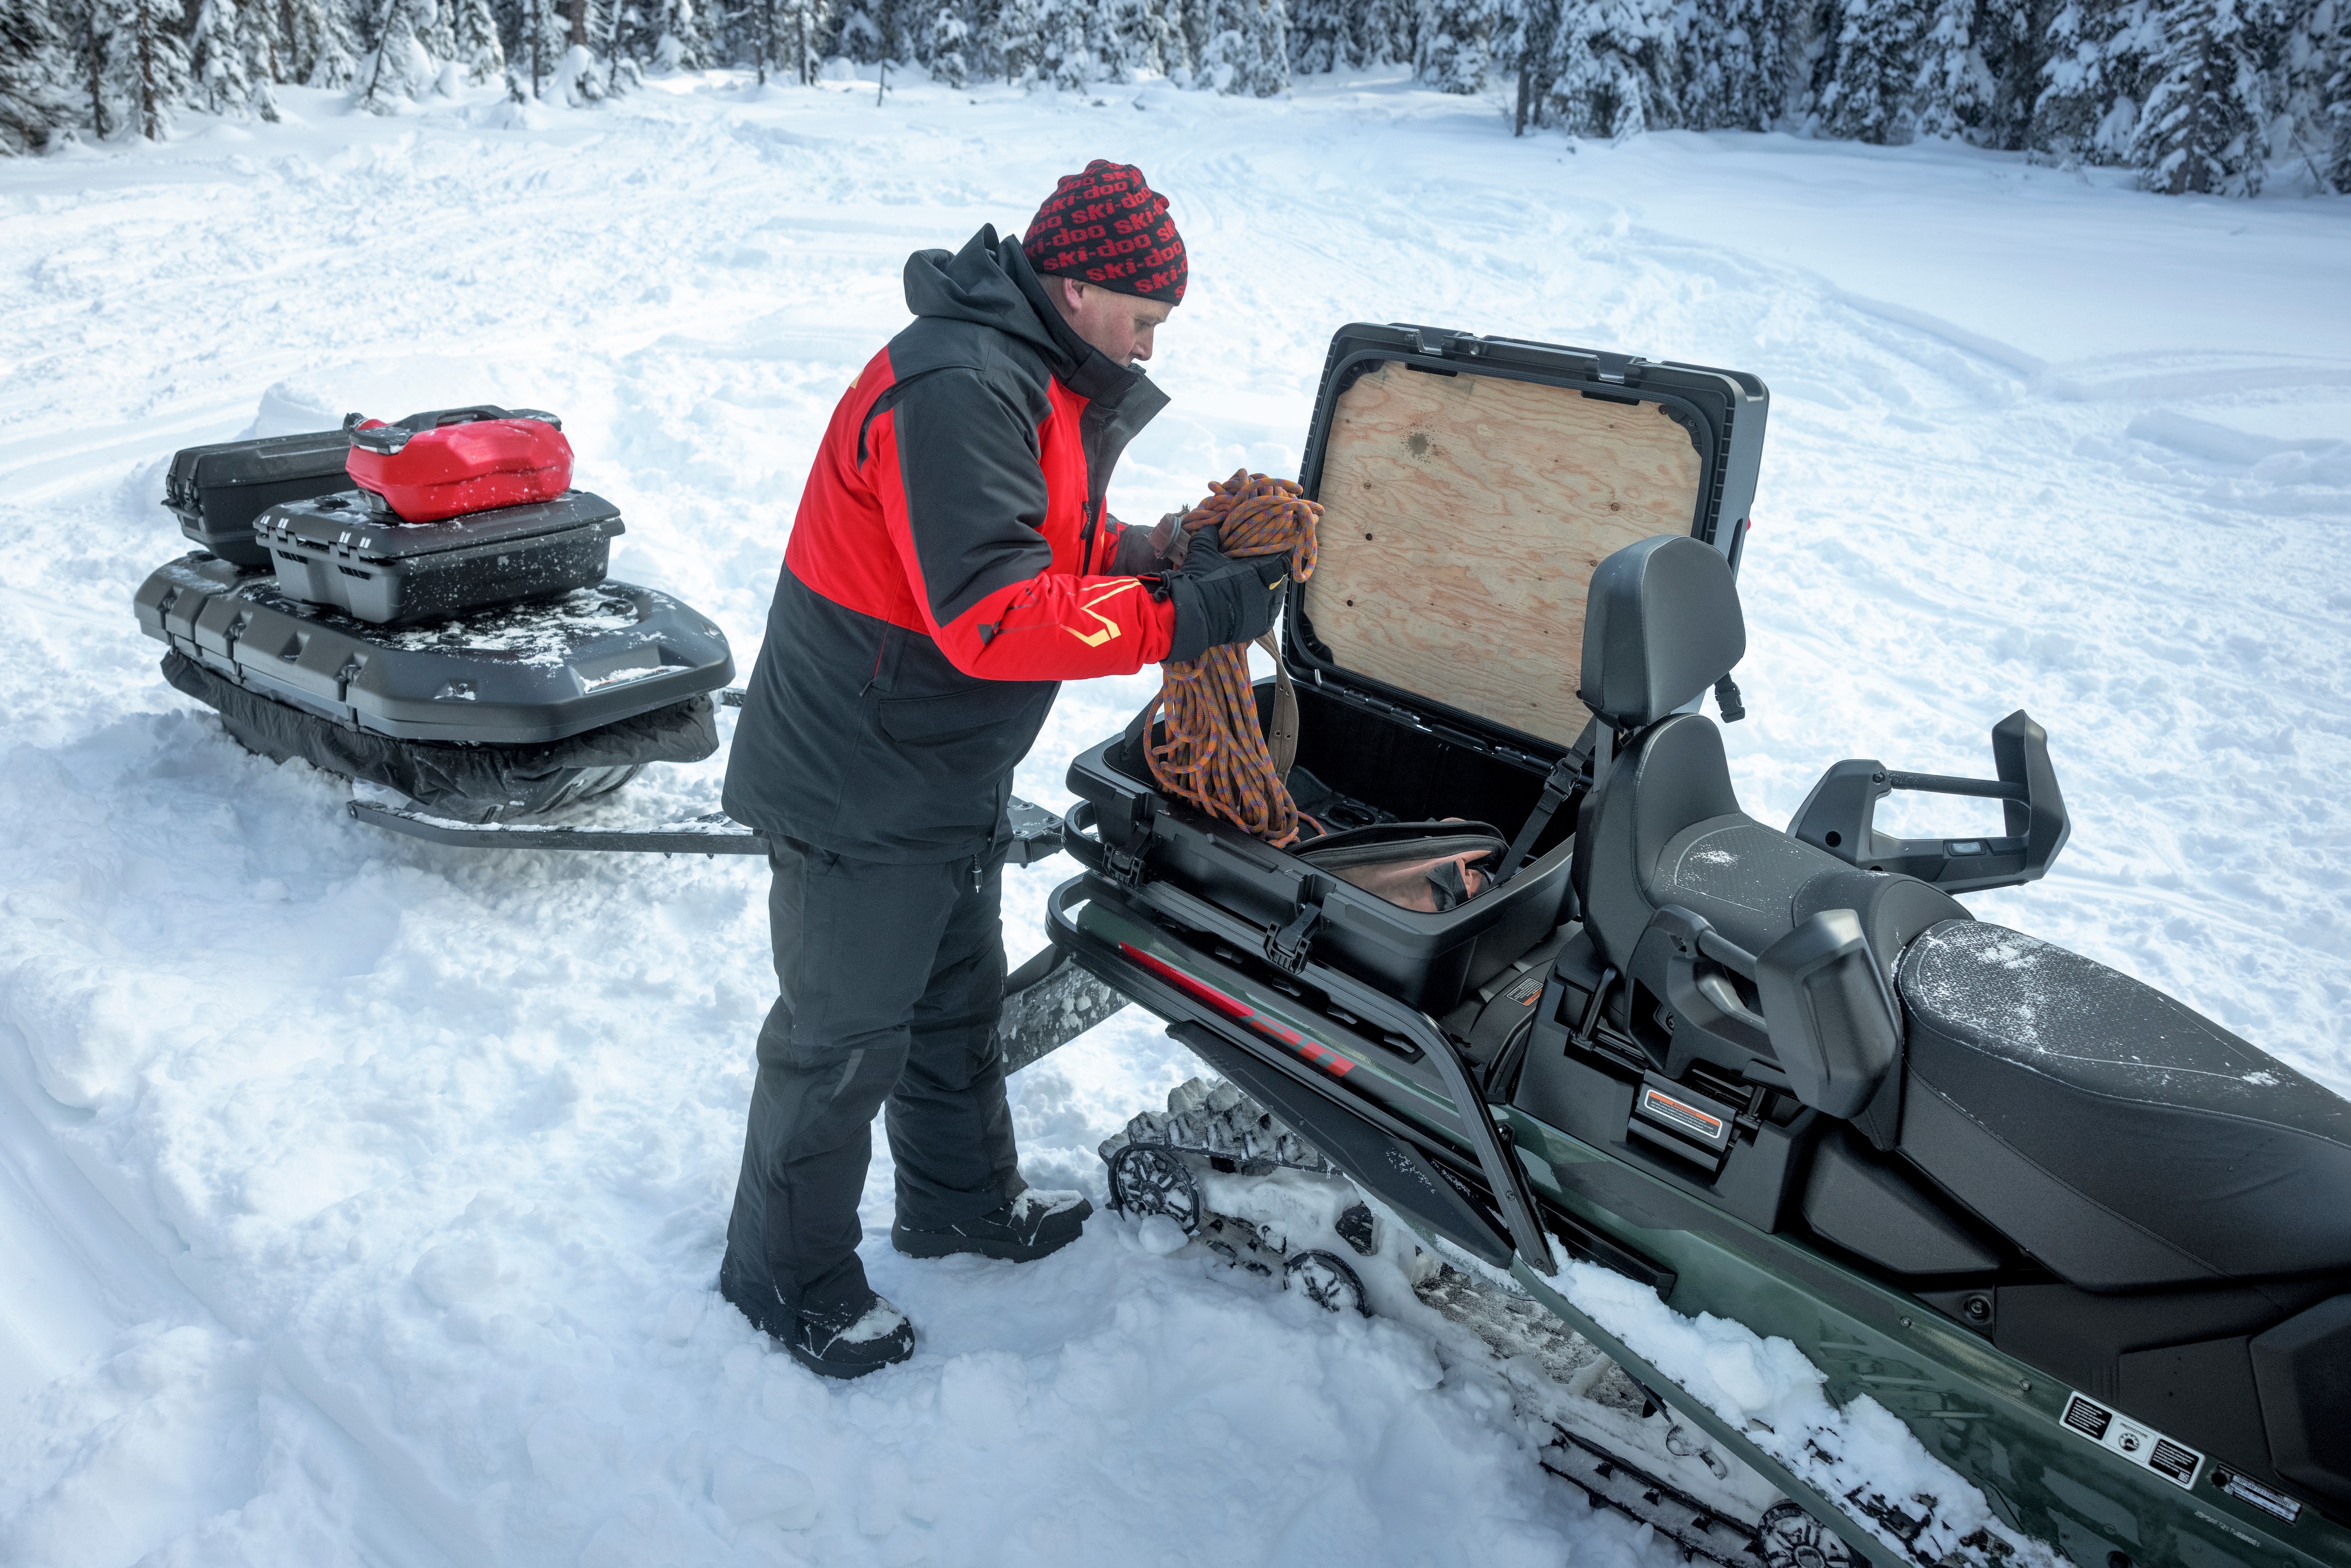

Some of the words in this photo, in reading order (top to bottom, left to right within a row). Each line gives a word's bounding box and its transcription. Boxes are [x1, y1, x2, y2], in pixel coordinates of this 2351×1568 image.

[1072, 188, 1152, 224] ski-doo
[1043, 234, 1151, 270] ski-doo
[1086, 240, 1183, 281] ski-doo
[1676, 1104, 1696, 1115] WARNING
[2120, 1422, 2148, 1439] PROTOTYPE
